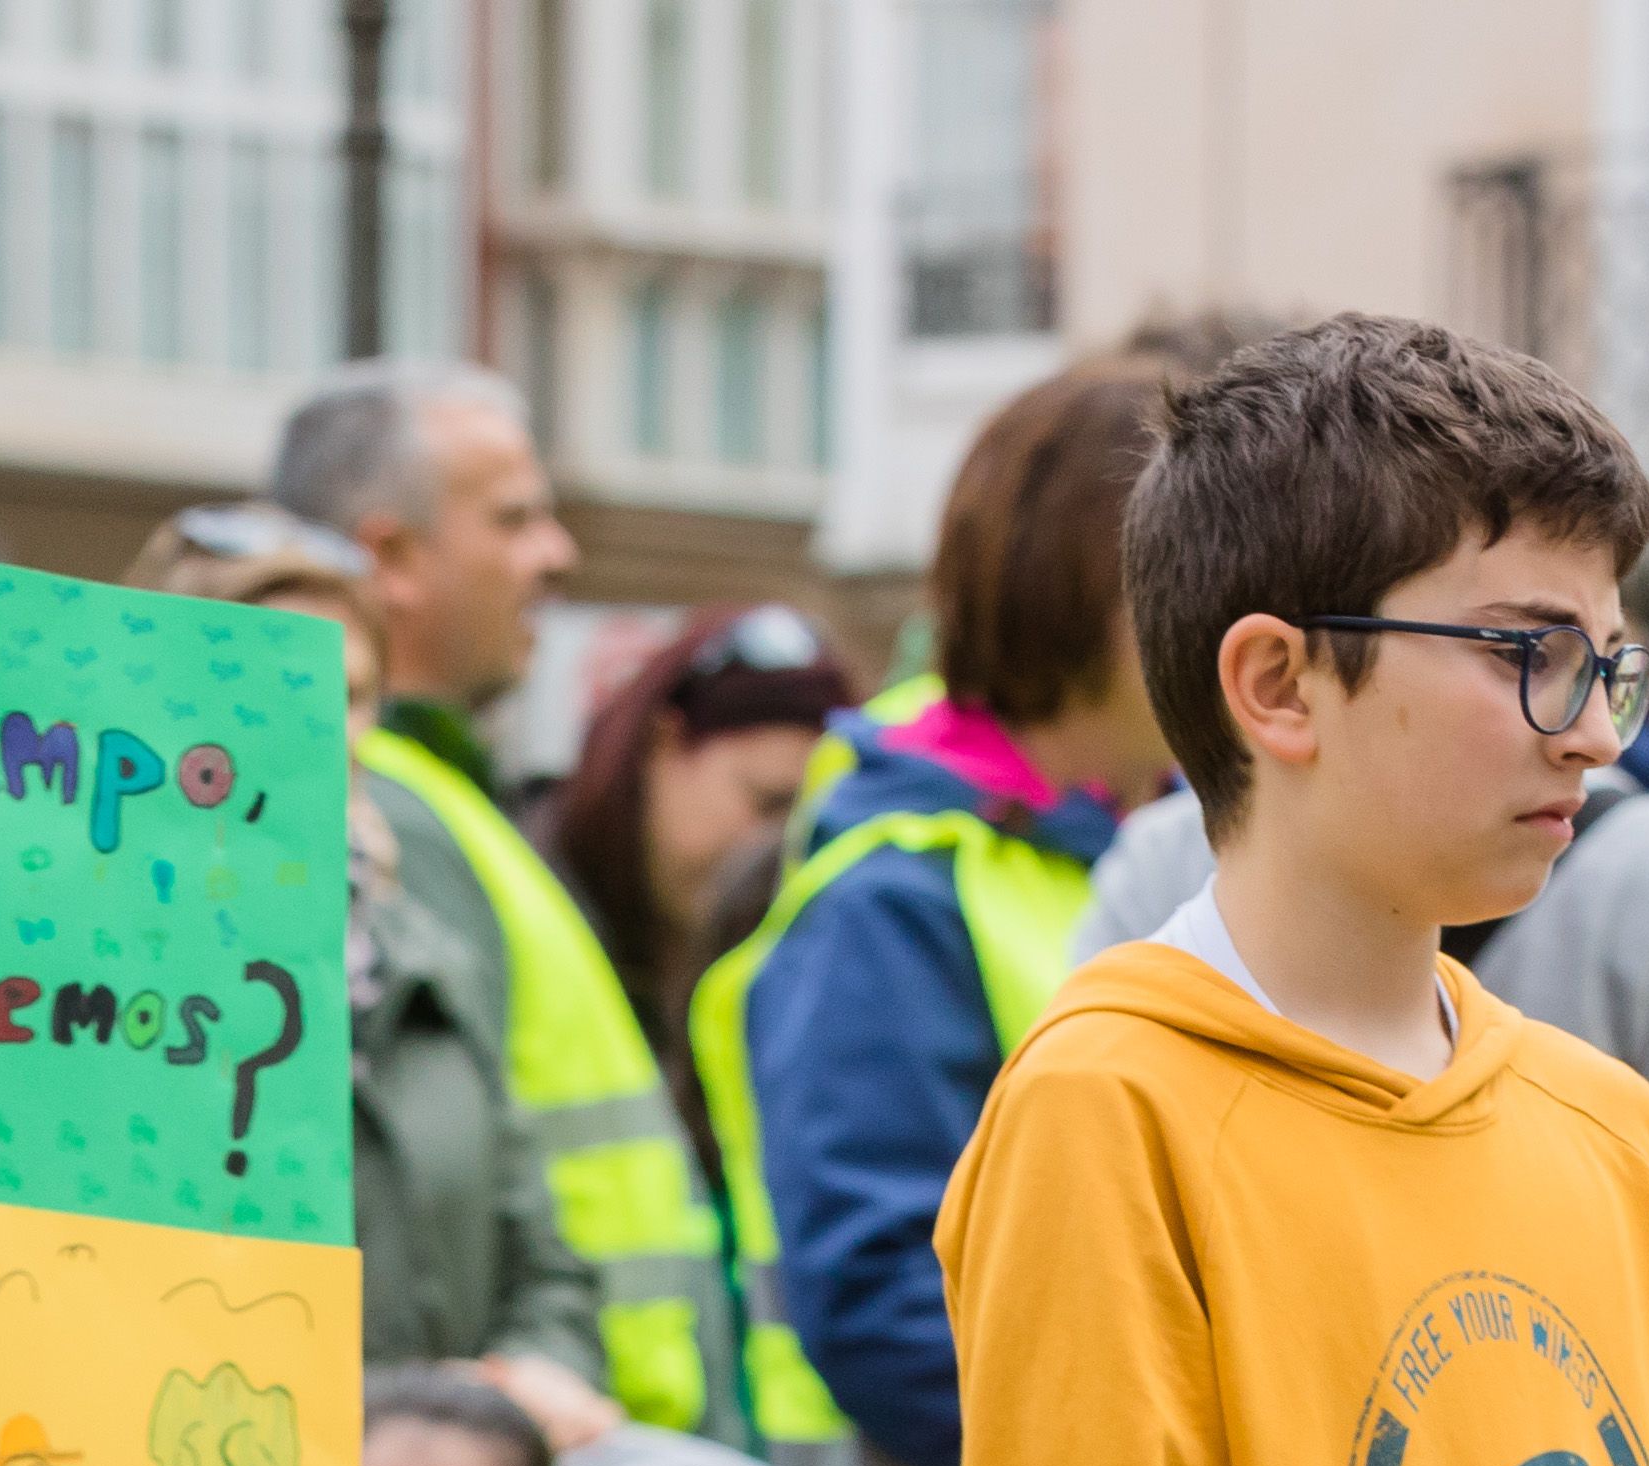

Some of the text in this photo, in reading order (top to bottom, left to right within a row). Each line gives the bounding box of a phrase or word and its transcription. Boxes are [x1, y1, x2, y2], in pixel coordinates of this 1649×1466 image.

[1392, 1291, 1598, 1413] FREE YOUR WINGS
